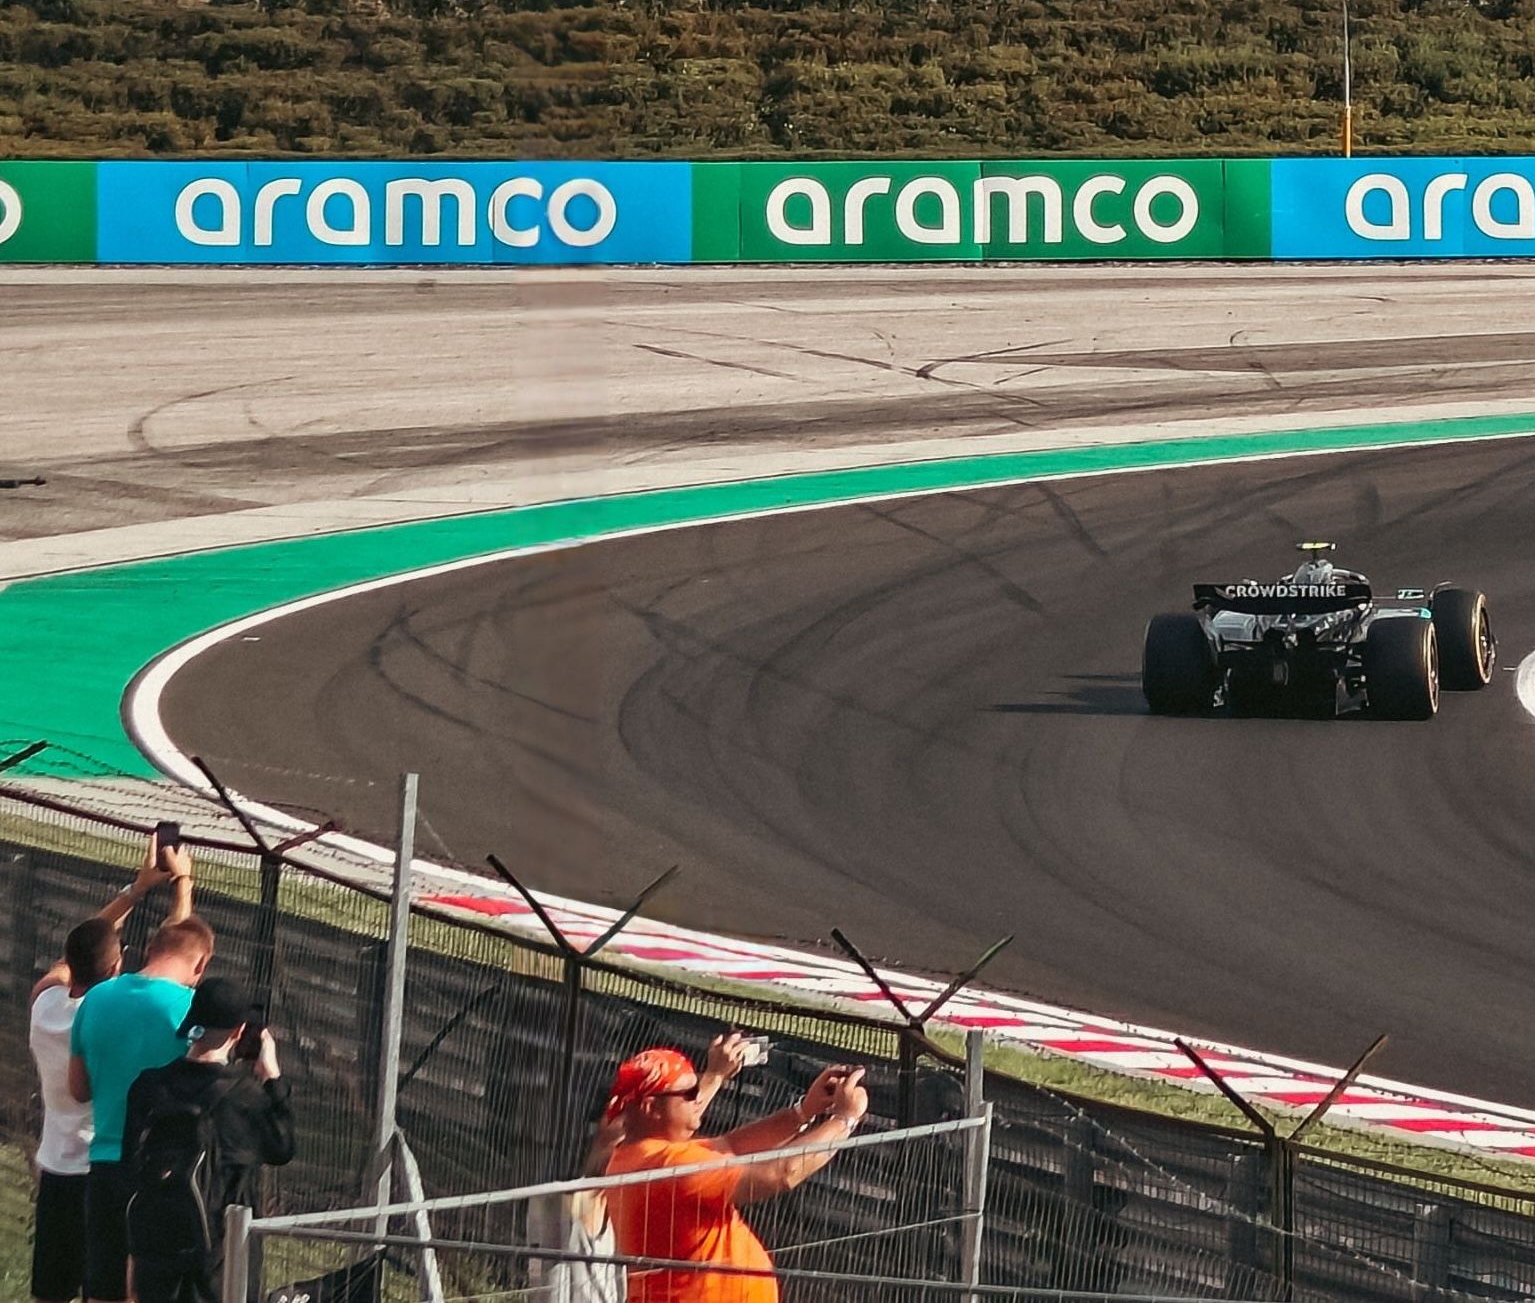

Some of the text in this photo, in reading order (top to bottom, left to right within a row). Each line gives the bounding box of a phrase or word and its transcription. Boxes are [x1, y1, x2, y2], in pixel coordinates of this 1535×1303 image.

[175, 178, 617, 247] aramco
[766, 175, 1199, 245] aramco
[1225, 584, 1346, 598] CROWDSTRIKE
